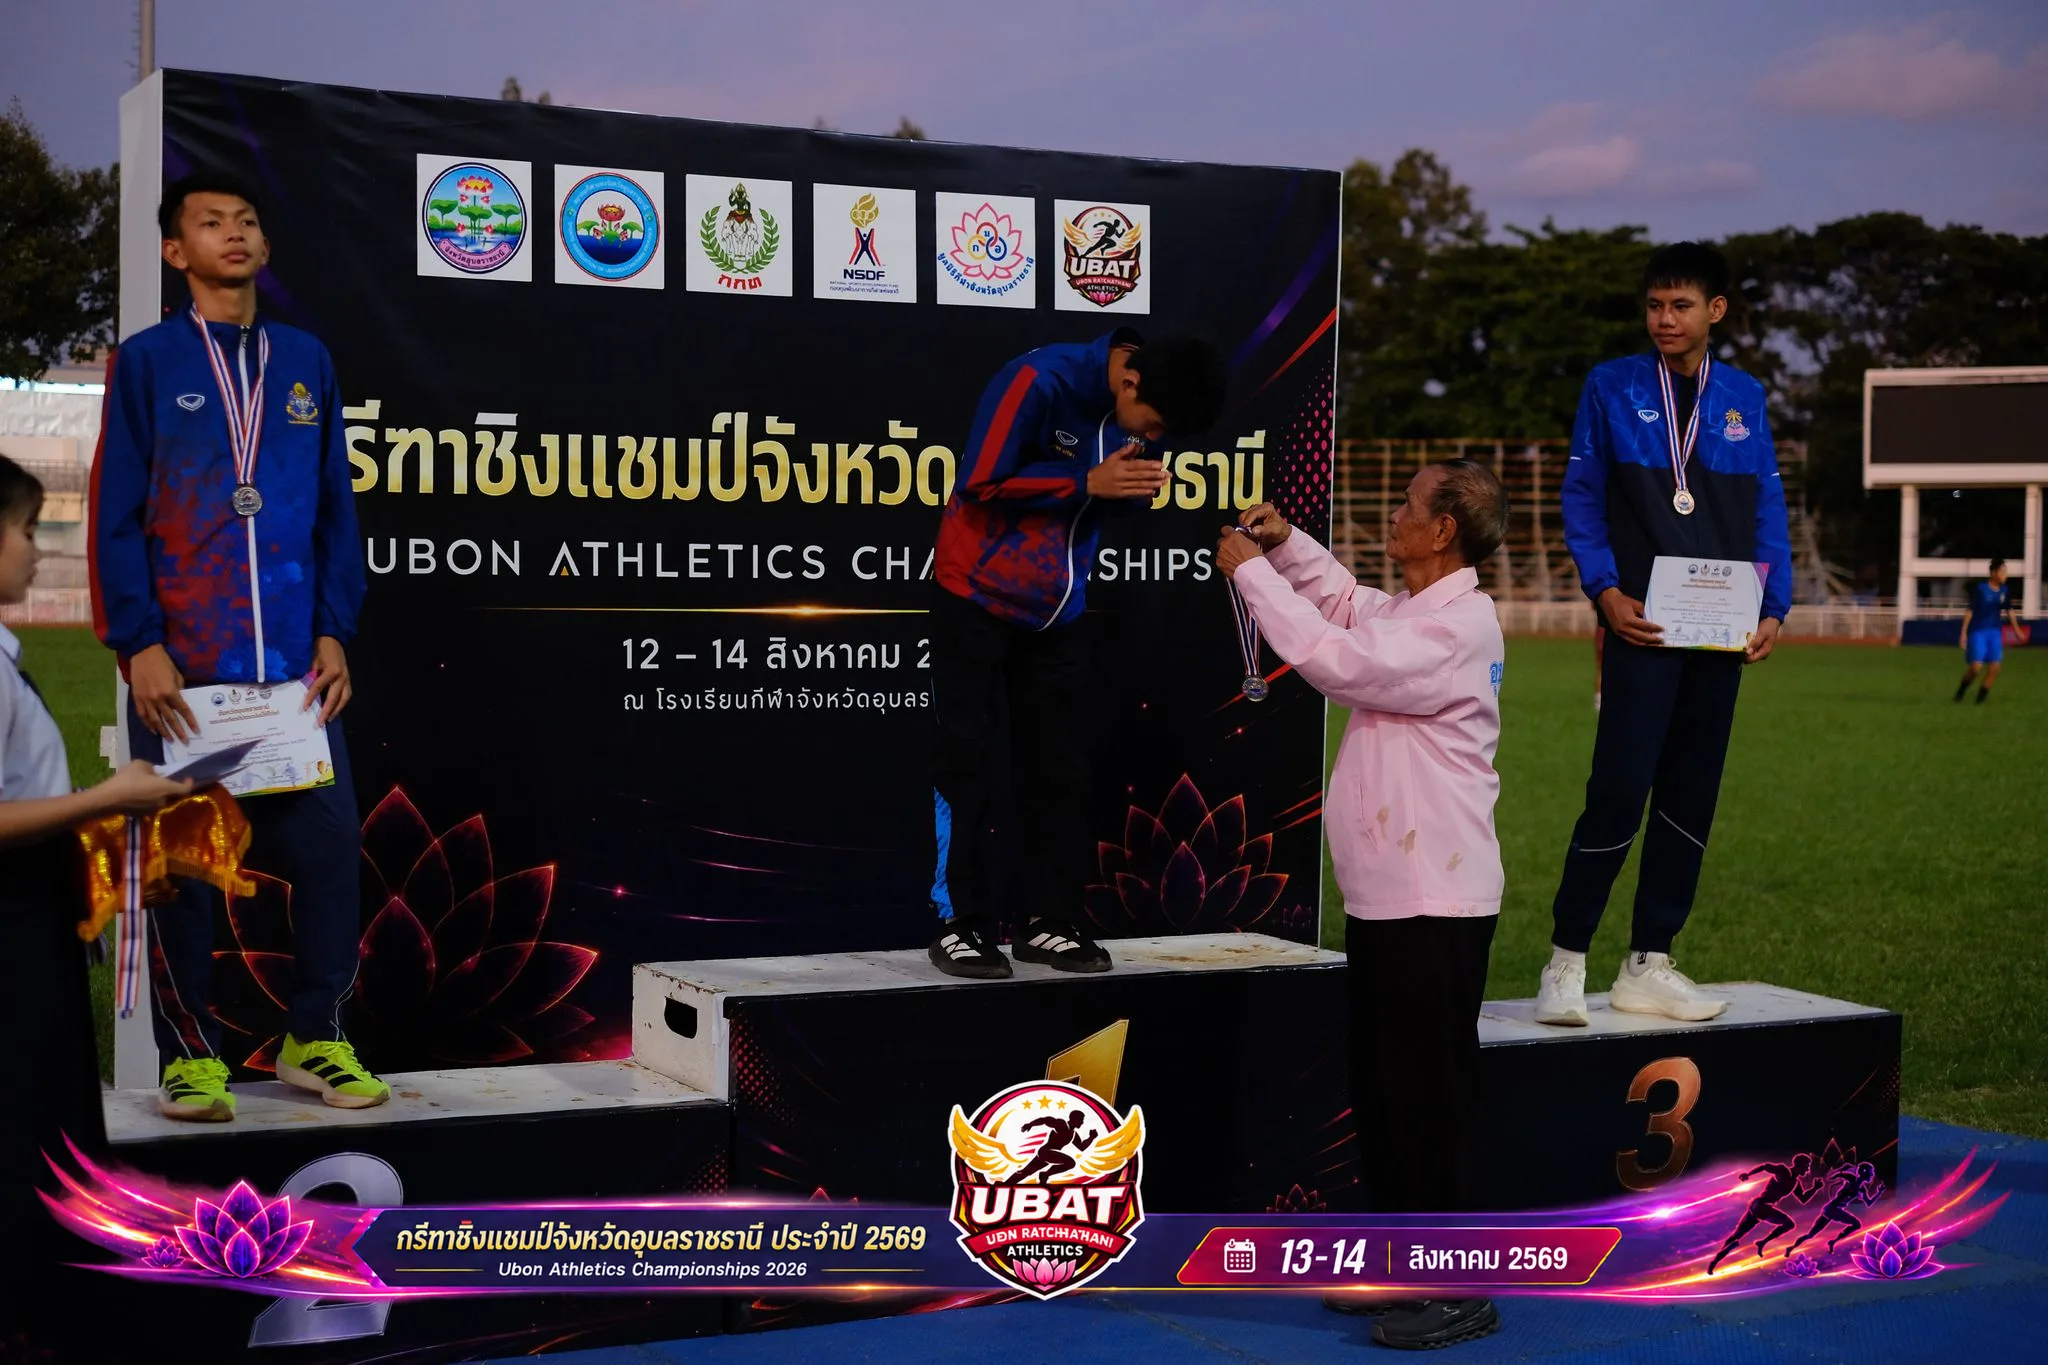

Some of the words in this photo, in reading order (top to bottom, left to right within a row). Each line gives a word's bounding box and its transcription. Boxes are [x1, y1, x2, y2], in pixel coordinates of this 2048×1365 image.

[972, 244, 980, 252] ก
[843, 268, 886, 281] NSDF
[1070, 256, 1136, 279] UBAT
[1086, 284, 1119, 292] ATHLETICS
[367, 537, 520, 575] UBON
[548, 541, 826, 580] ATHLETICS
[622, 638, 660, 669] 12
[712, 638, 749, 669] 14
[766, 636, 901, 669] สิงหาคม
[623, 693, 644, 710] ณ
[656, 686, 930, 715] โรงเรียนกีฬาจังหวัดอุบลร
[1616, 1057, 1701, 1192] 3
